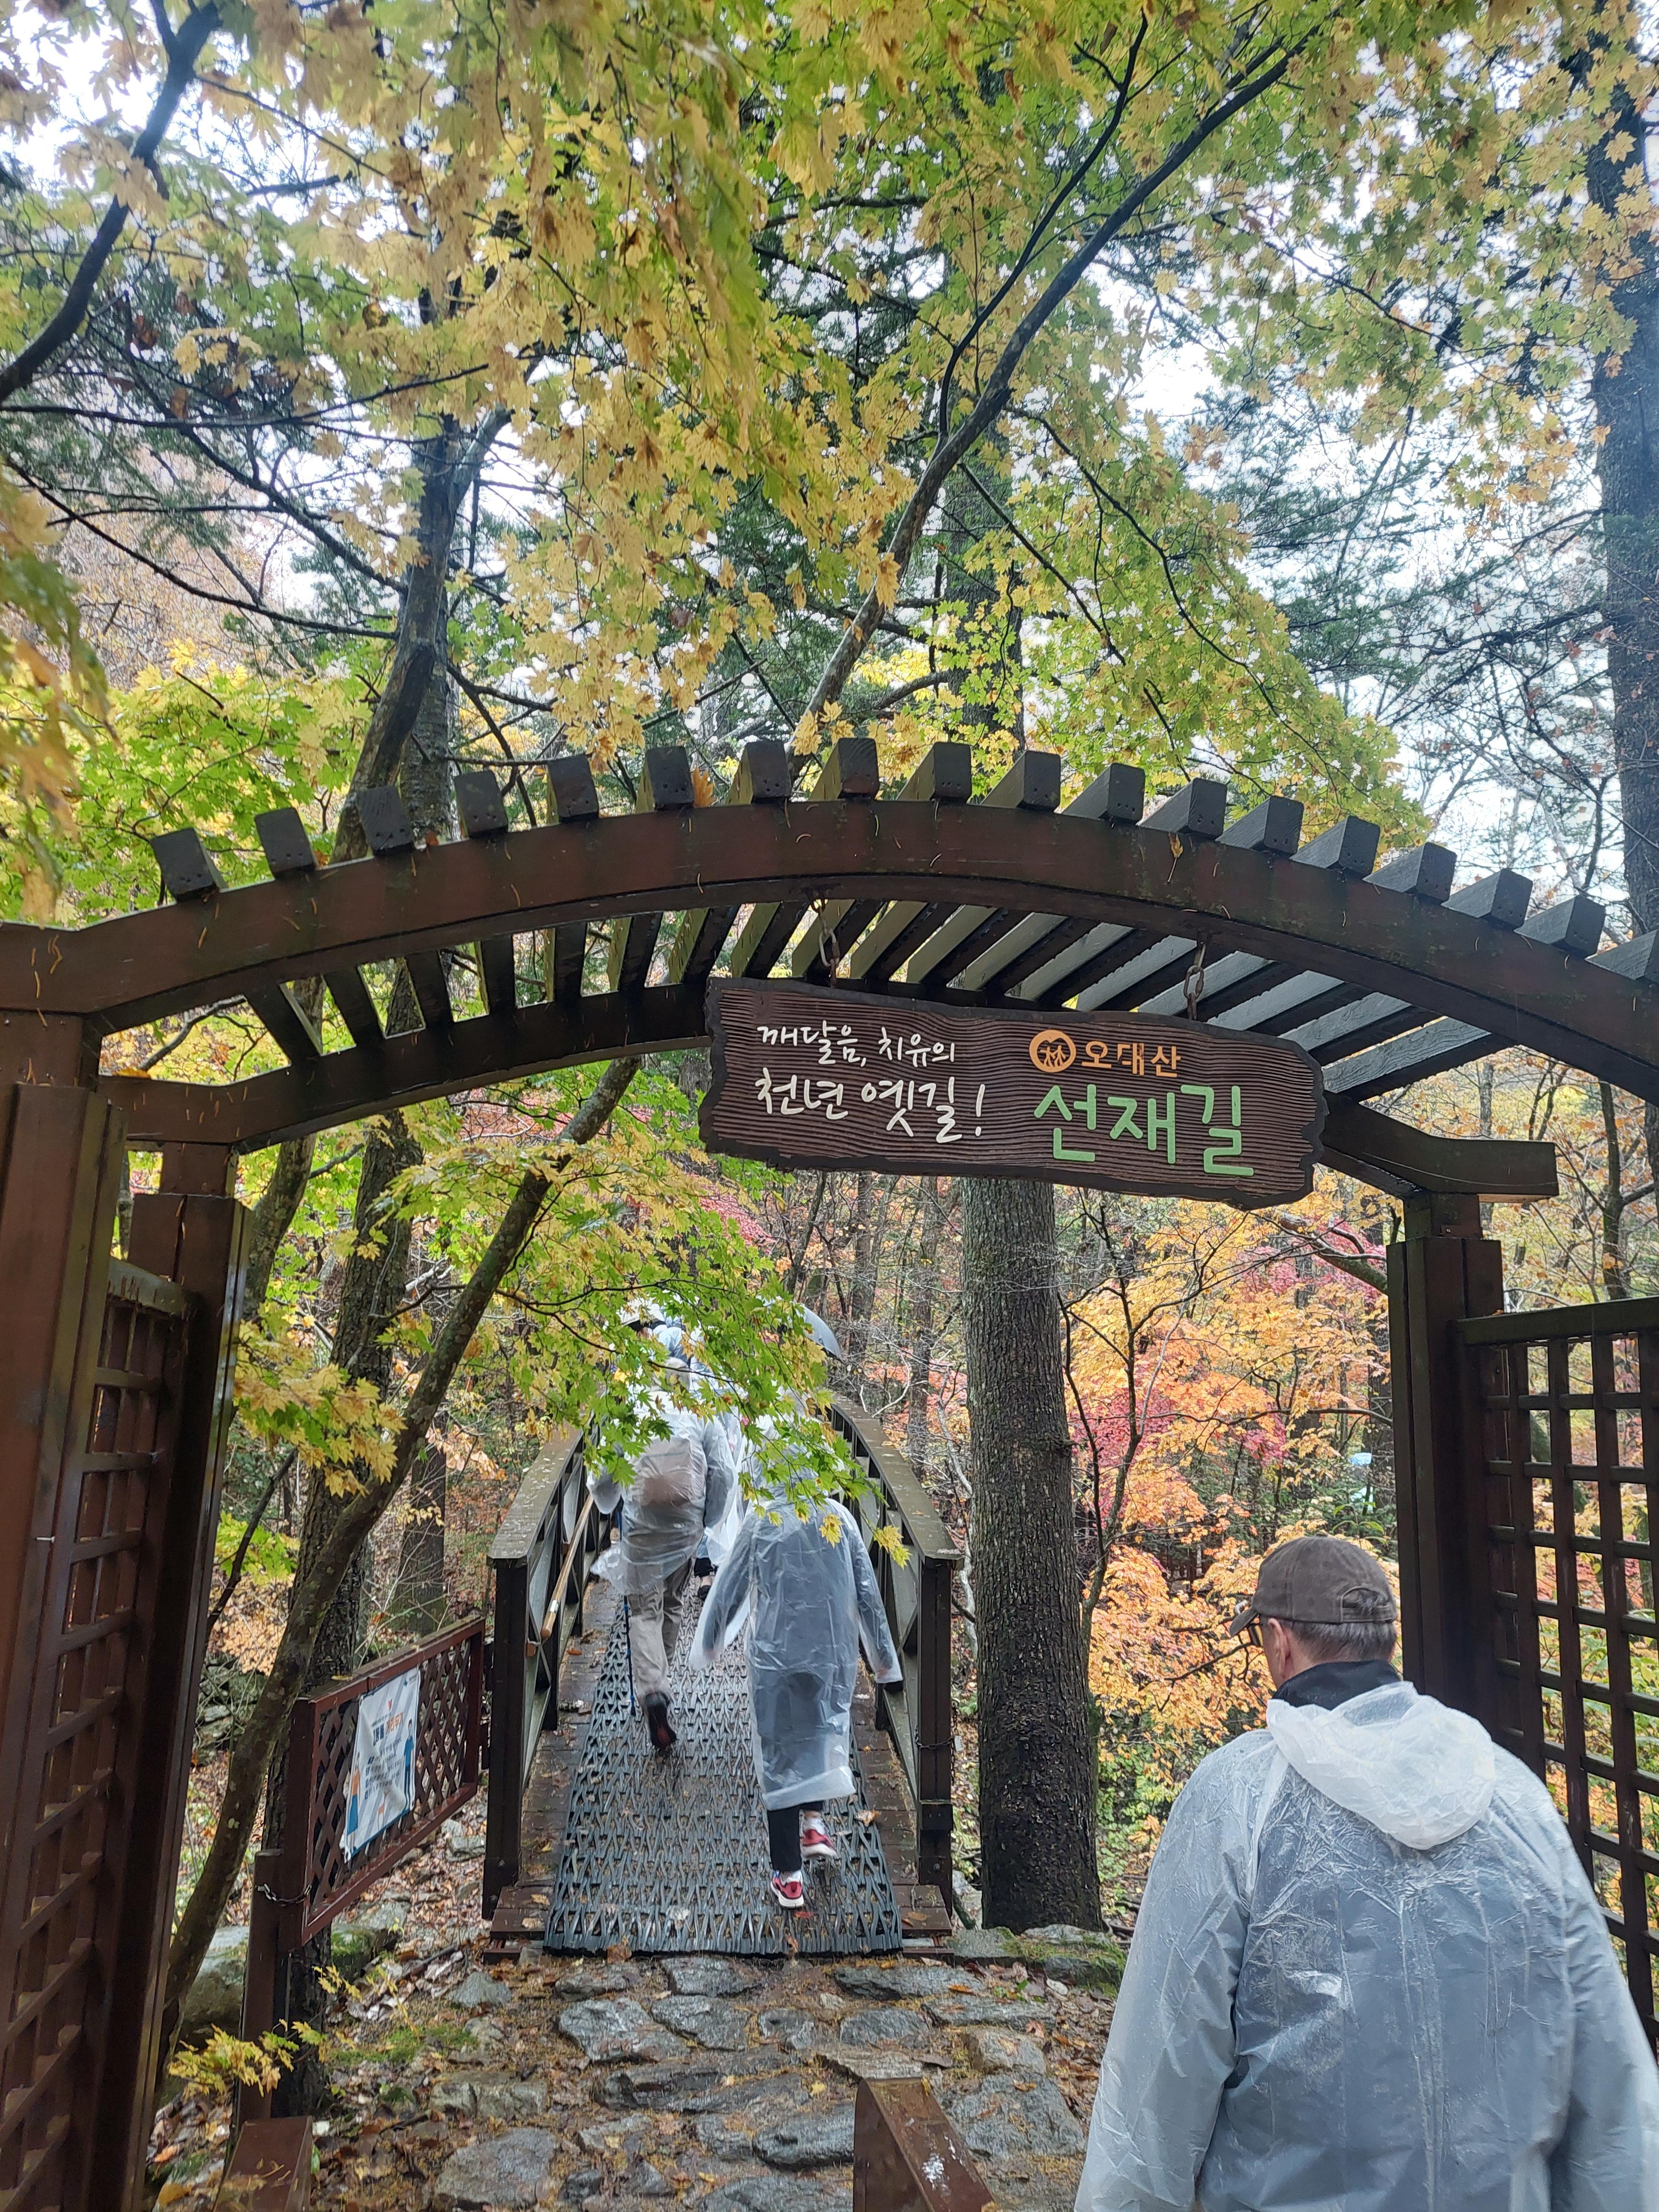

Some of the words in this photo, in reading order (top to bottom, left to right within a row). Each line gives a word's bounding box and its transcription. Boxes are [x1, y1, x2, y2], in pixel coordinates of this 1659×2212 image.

[757, 1019, 867, 1067] 깨달음,
[878, 1027, 955, 1065] 치유의
[1081, 1040, 1181, 1078] 오대산
[754, 1067, 849, 1120] 천년
[861, 1076, 986, 1143] 옛길!
[1034, 1084, 1254, 1177] 선재길
